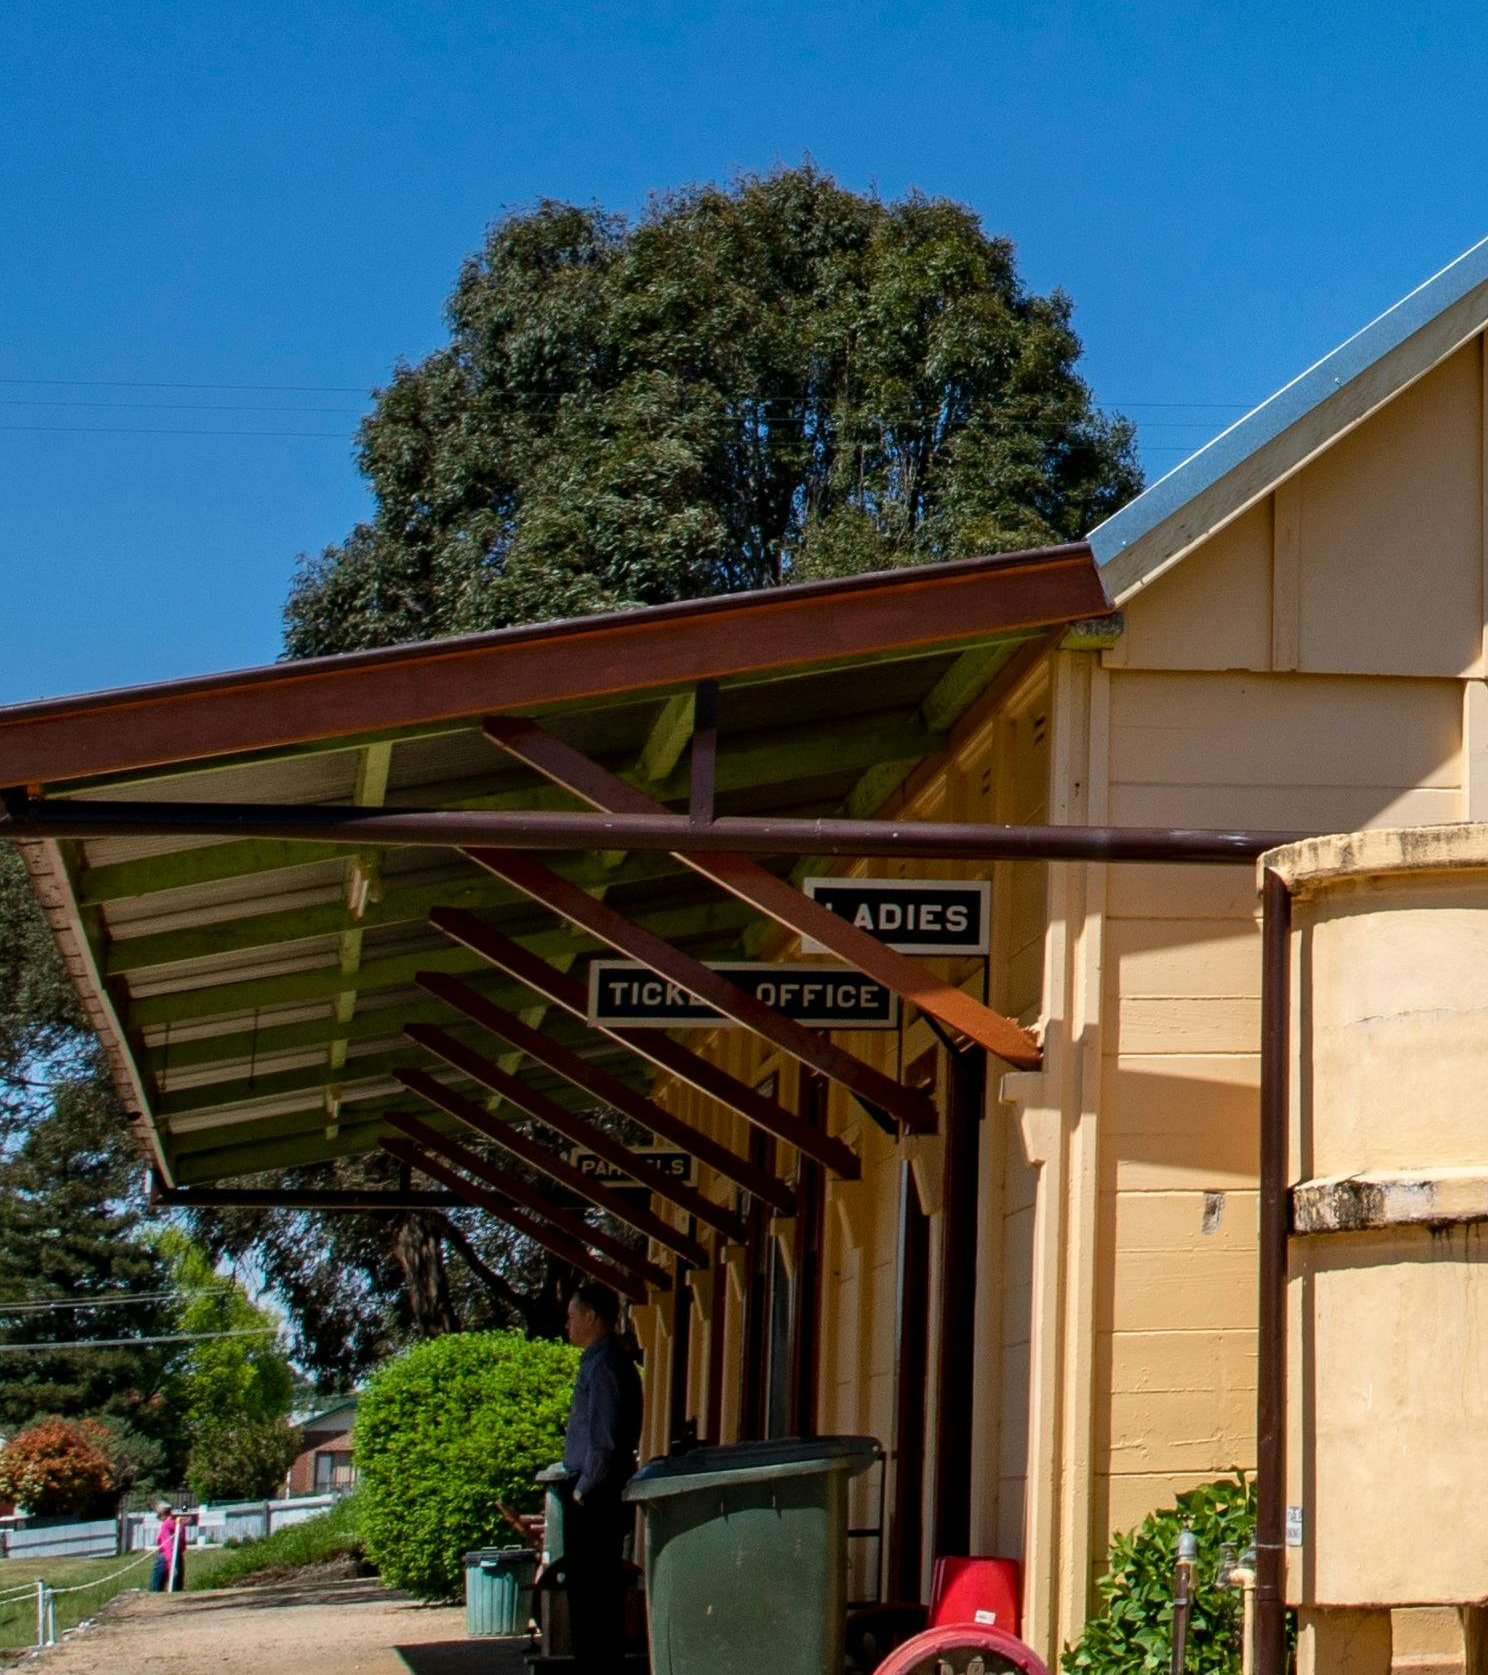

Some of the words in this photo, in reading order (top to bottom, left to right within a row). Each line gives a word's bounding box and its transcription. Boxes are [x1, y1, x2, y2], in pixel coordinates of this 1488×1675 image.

[826, 902, 969, 933] ADIES
[609, 982, 709, 1007] TICK
[756, 982, 880, 1008] OFFICE
